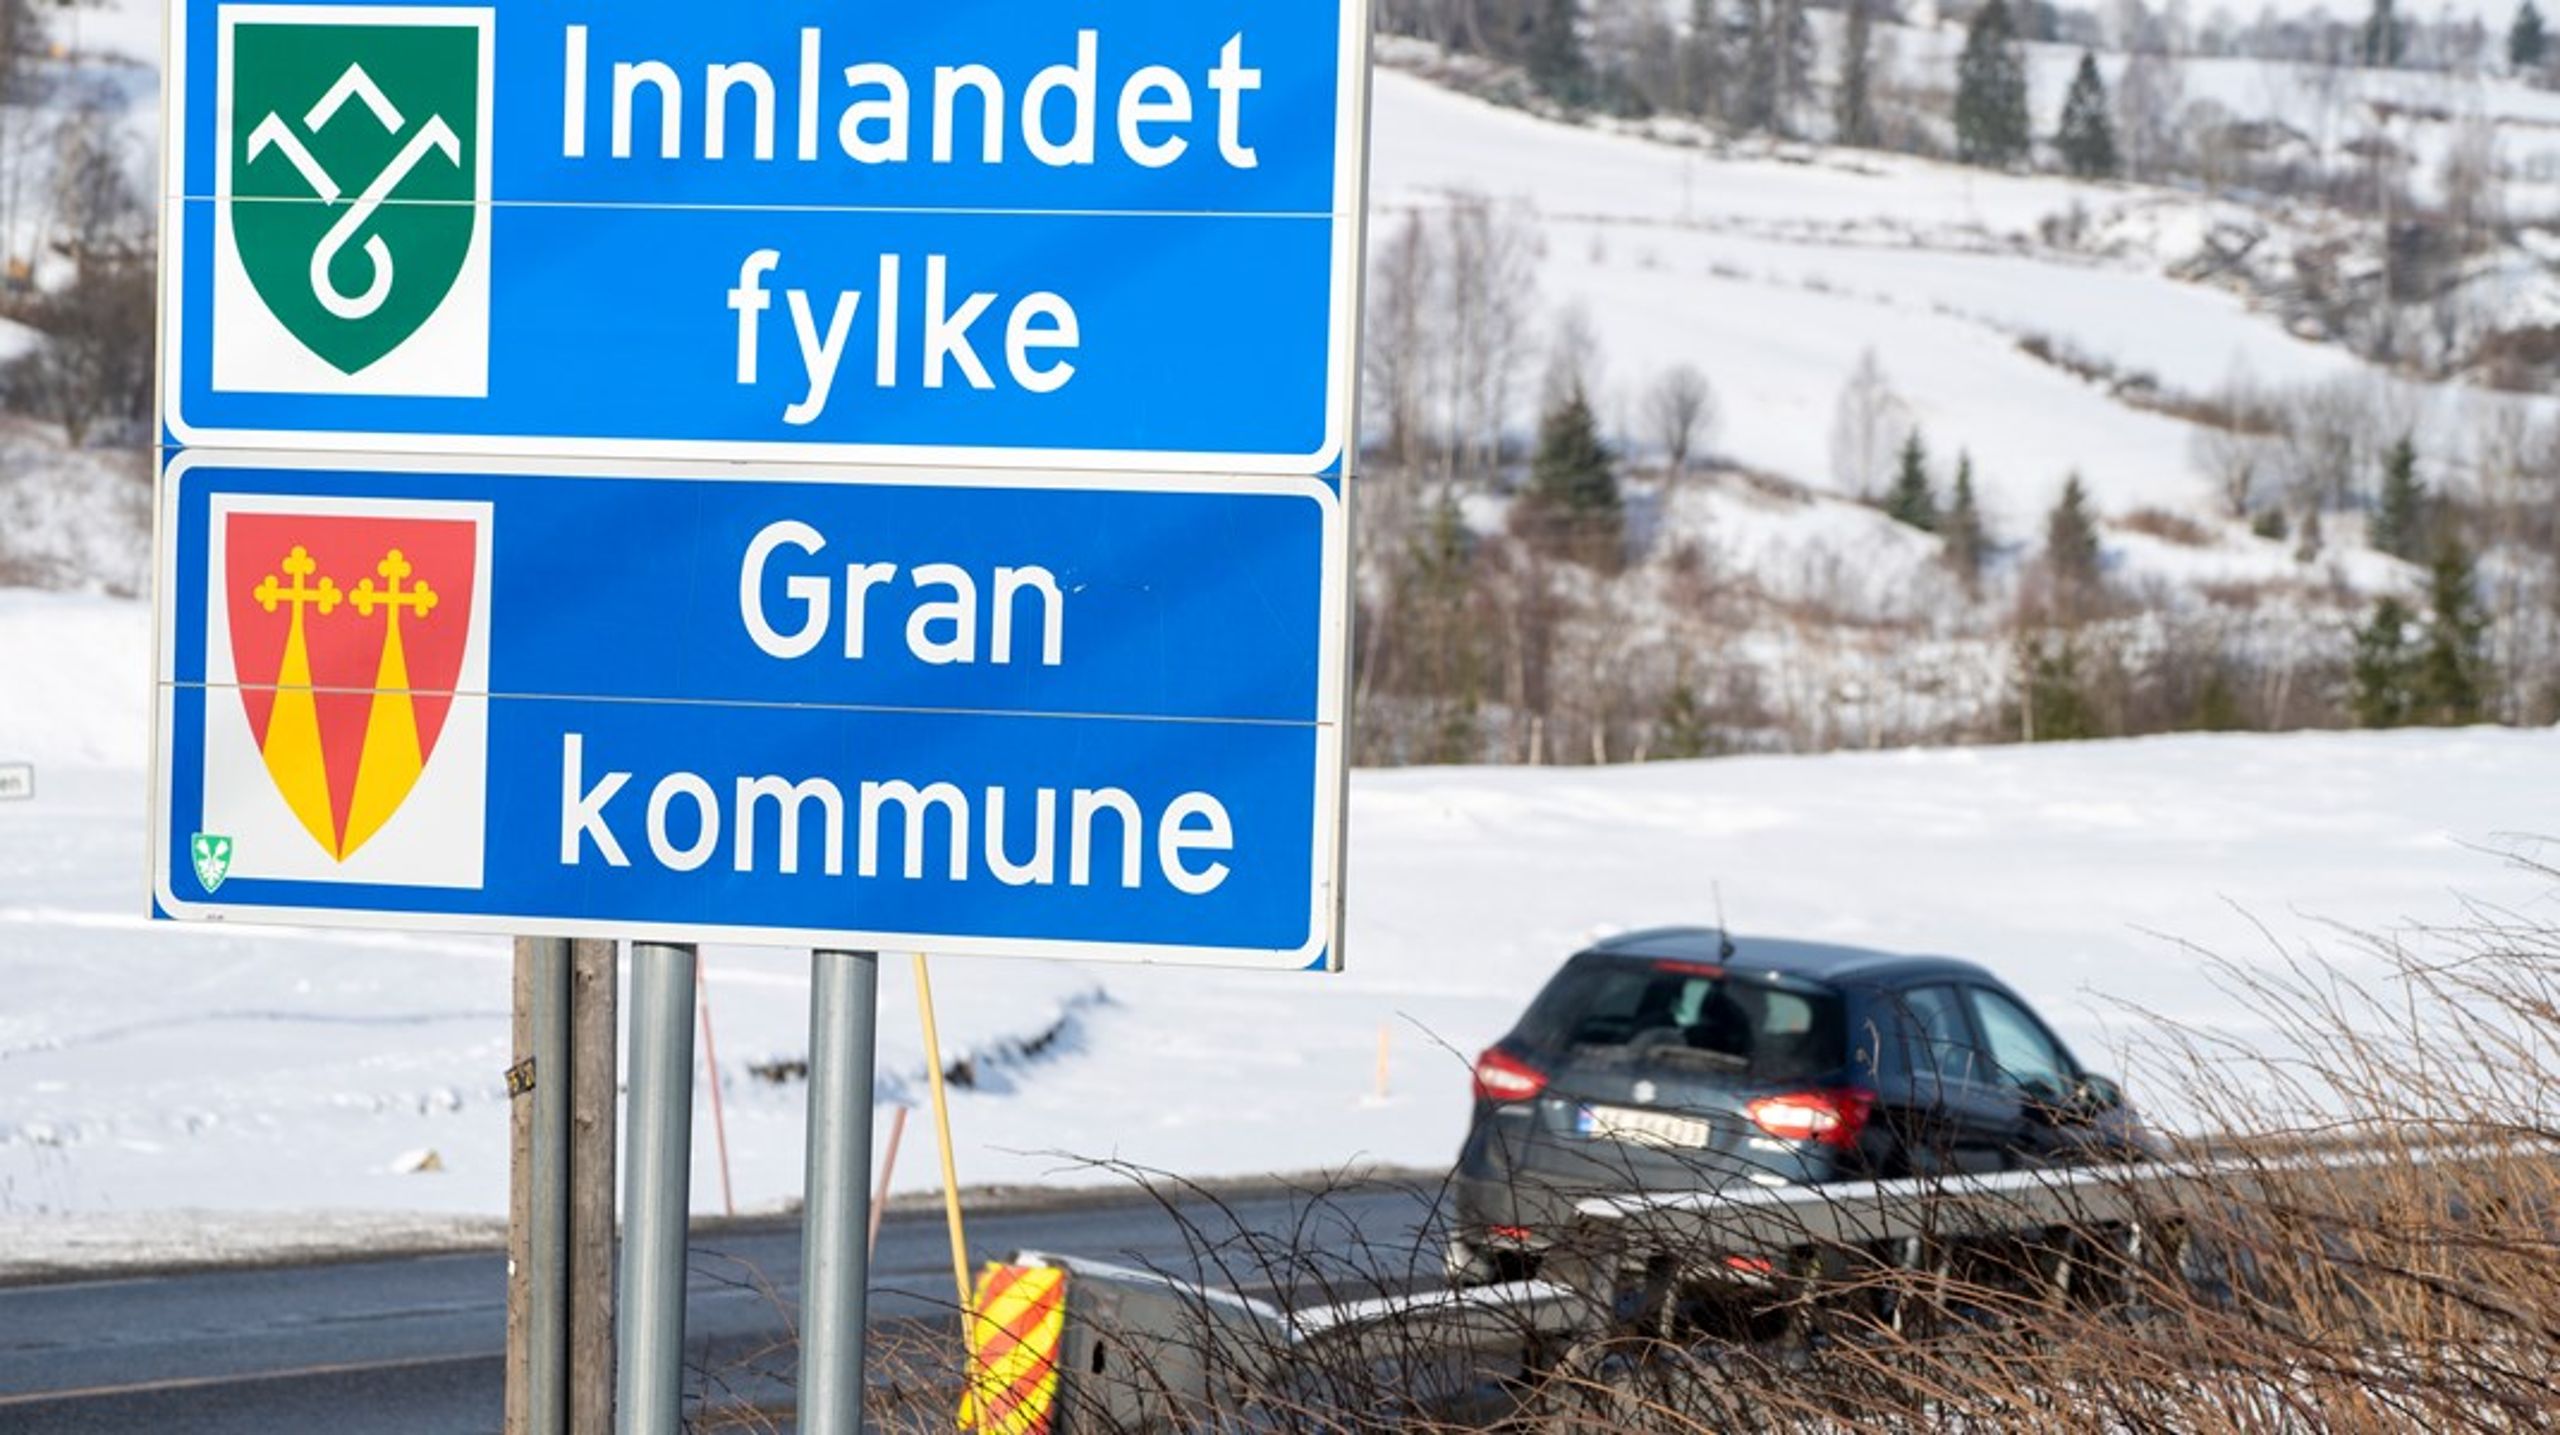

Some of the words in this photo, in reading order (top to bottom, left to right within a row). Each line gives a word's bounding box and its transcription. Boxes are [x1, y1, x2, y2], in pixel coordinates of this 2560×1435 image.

[562, 25, 1261, 168] Innlandet
[727, 249, 1080, 426] fylke
[740, 520, 1064, 665] Gran
[561, 733, 1234, 894] kommune
